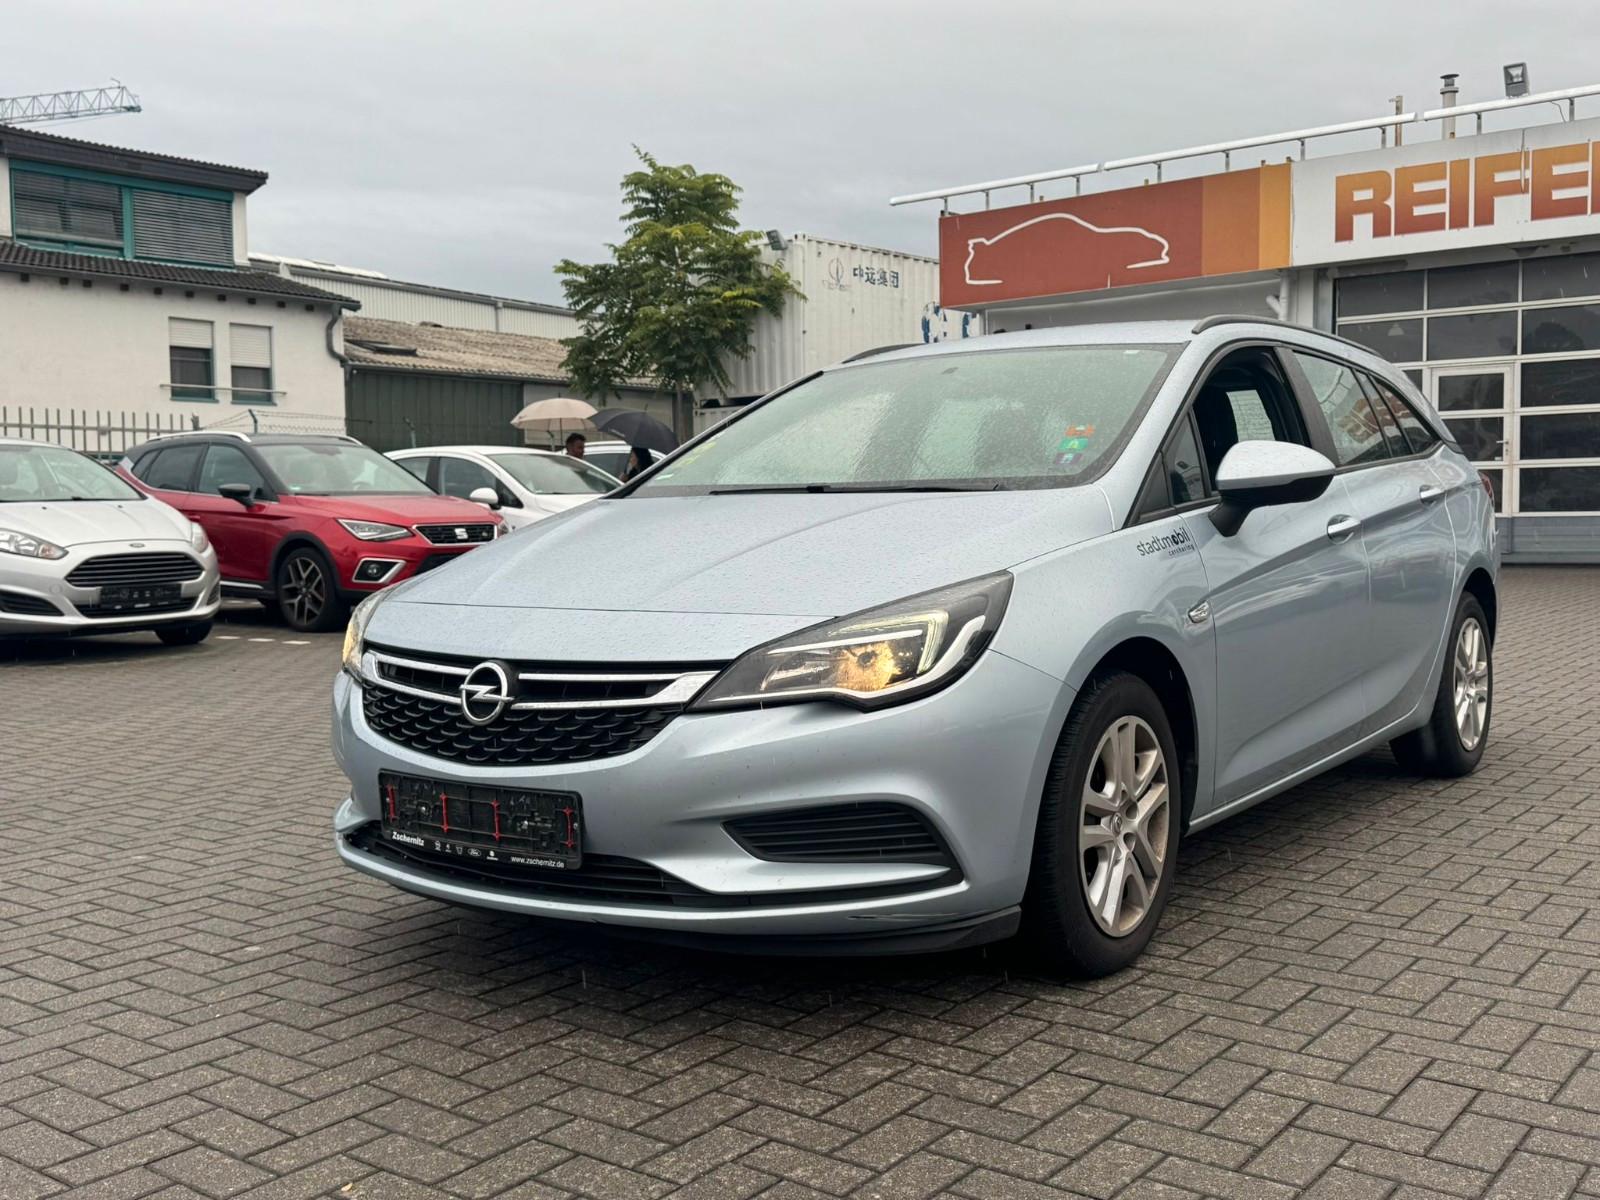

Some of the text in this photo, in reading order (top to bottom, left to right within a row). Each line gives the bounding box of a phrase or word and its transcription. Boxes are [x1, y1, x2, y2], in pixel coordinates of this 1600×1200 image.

[1335, 141, 1600, 243] REIFE
[853, 264, 899, 288] 中远集团
[1136, 527, 1191, 556] stadtmobil
[1168, 544, 1195, 556] carsharing
[392, 831, 425, 847] Zschernitz
[511, 856, 565, 869] www.zschernitz.de
